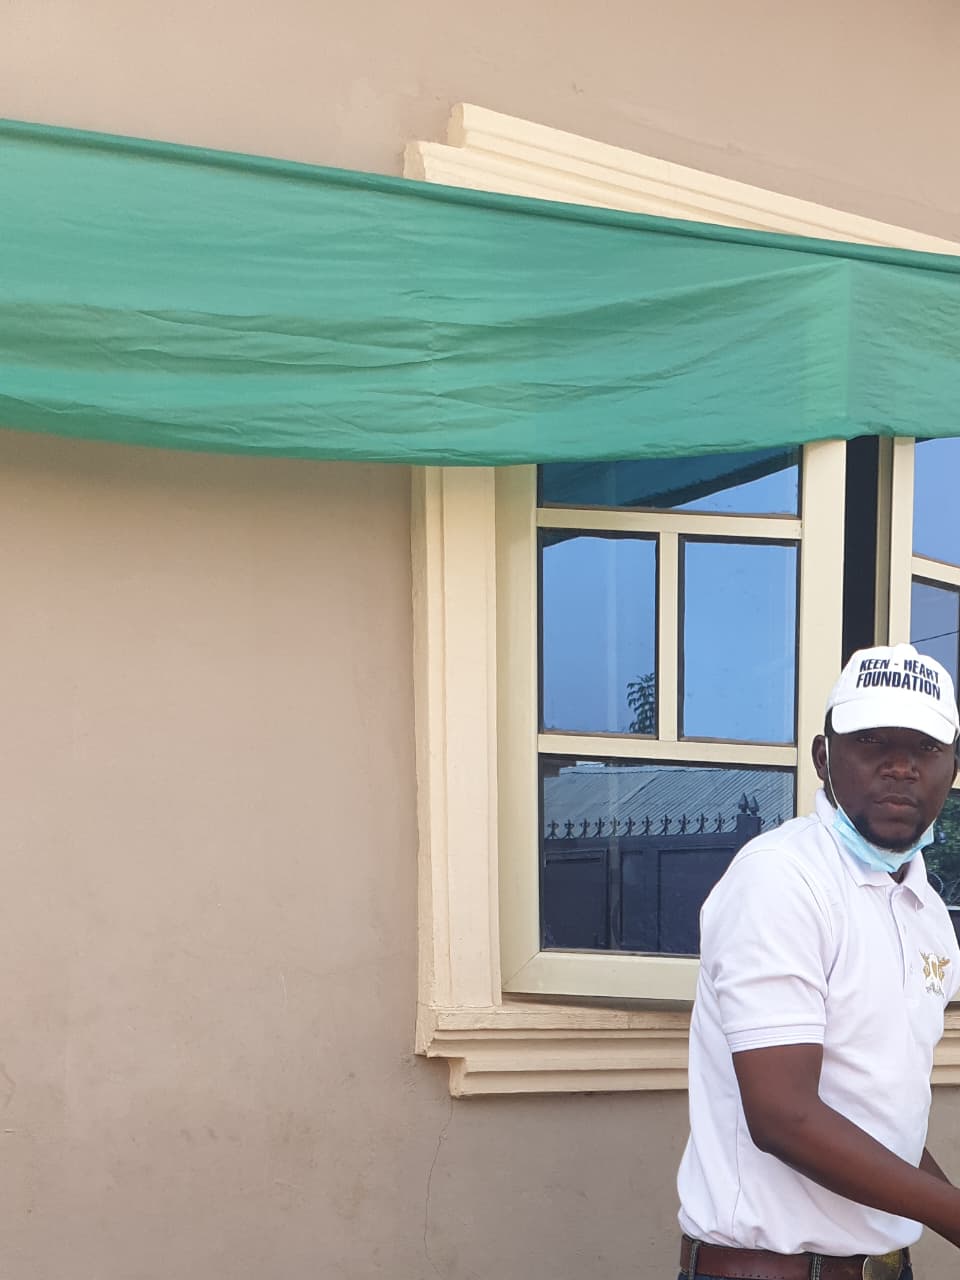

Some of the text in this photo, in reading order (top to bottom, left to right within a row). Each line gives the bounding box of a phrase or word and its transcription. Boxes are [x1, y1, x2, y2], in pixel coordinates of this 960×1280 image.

[860, 658, 940, 684] KEEN HEART
[856, 671, 940, 700] FOUNDATION
